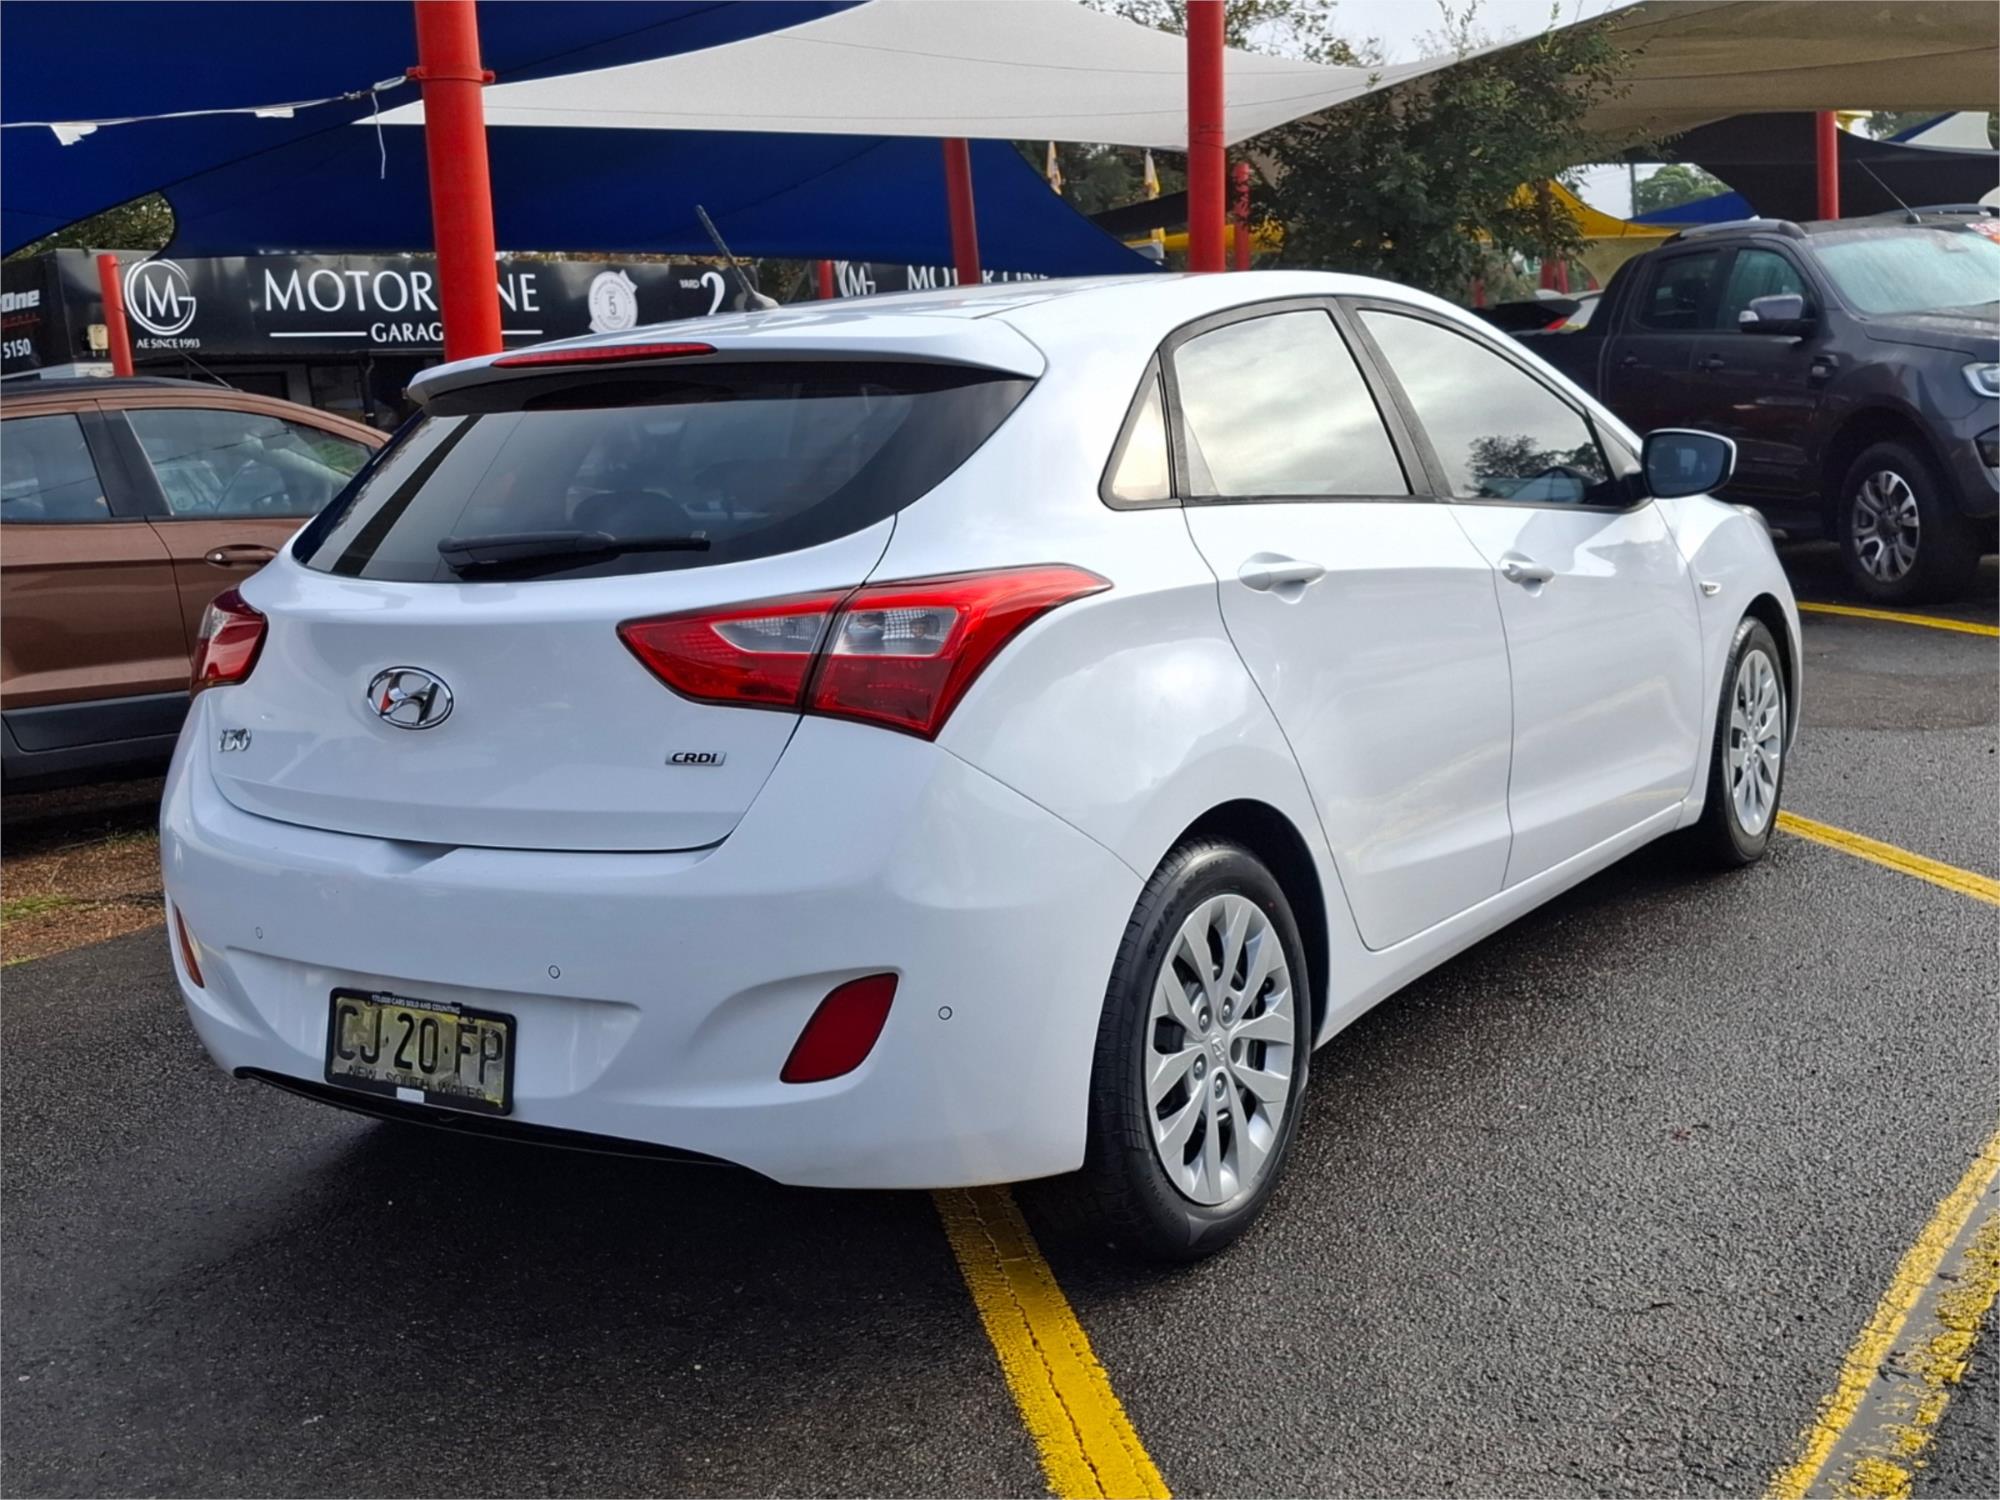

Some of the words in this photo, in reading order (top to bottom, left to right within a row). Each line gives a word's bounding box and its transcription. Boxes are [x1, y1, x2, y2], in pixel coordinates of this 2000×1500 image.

[495, 273, 541, 312] NE
[678, 278, 700, 289] YARD
[700, 271, 726, 316] 2
[607, 295, 617, 316] 5
[370, 322, 444, 342] GARAG
[2, 337, 32, 360] 5150
[151, 338, 178, 349] SINCE
[179, 338, 201, 349] 1993
[671, 751, 718, 764] CRDI
